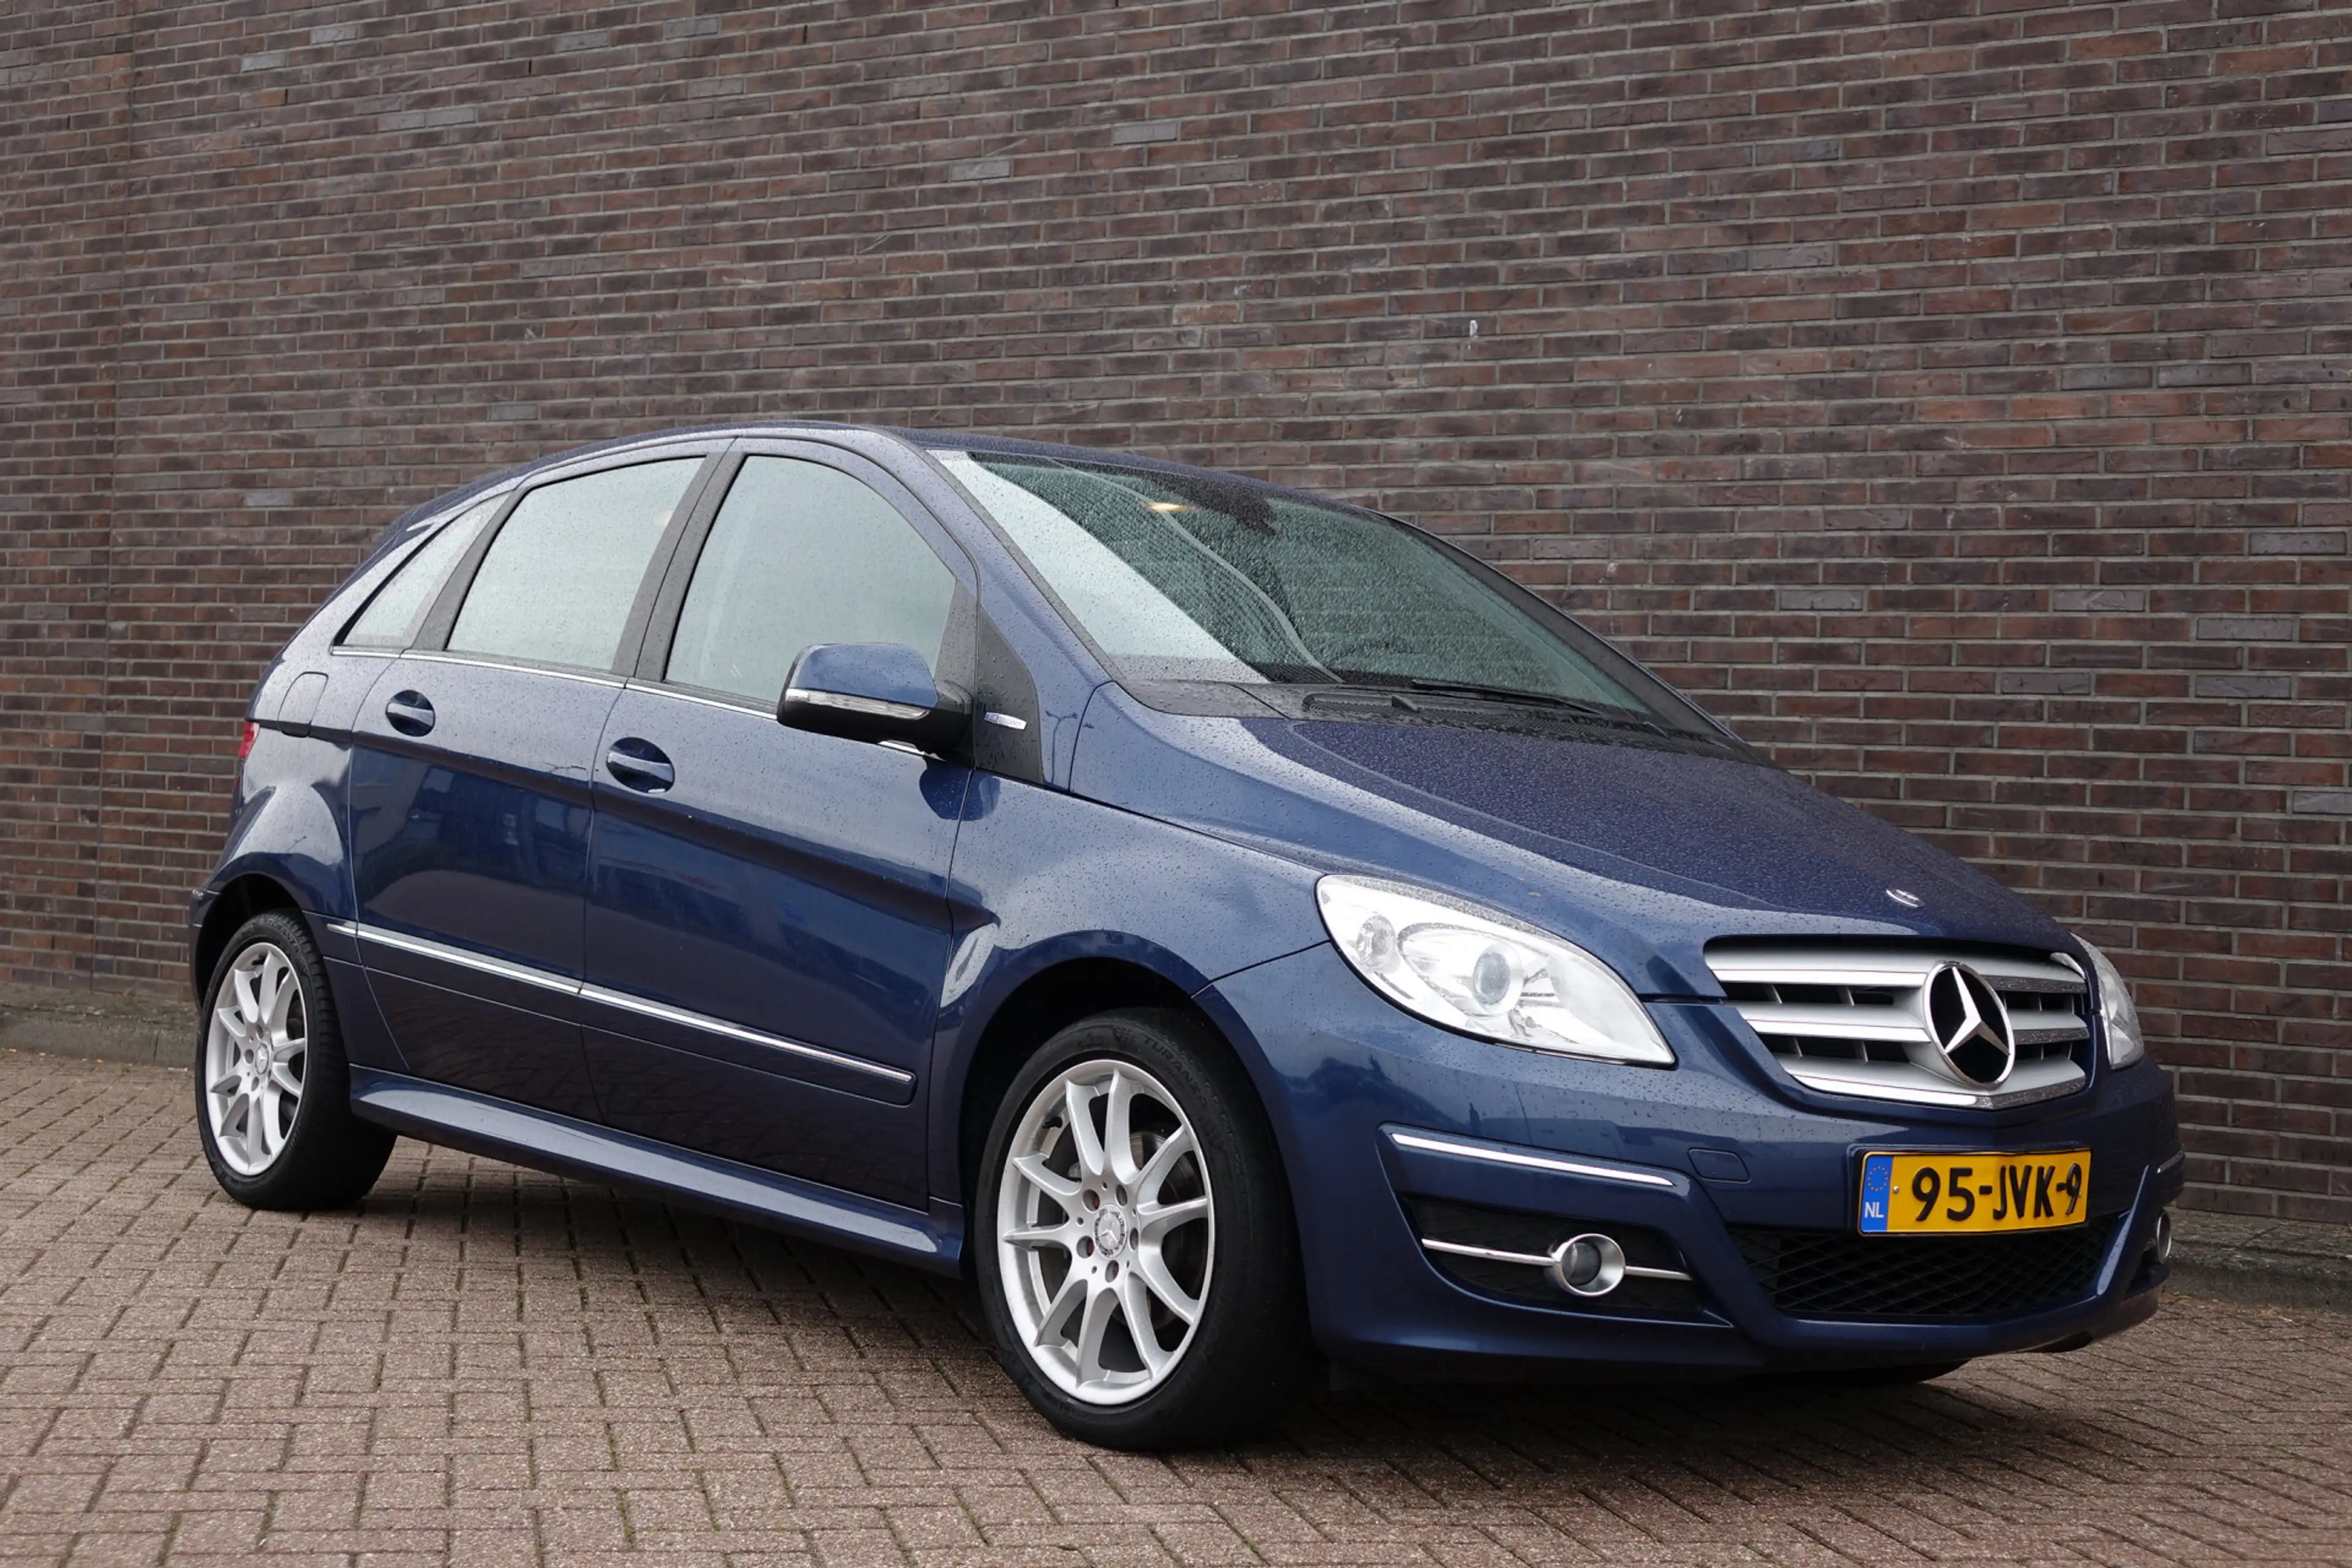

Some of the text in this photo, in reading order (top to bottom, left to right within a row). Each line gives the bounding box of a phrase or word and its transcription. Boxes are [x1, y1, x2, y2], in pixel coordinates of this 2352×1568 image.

[267, 919, 300, 954] TURANZA
[1144, 1035, 1208, 1108] TURANZA
[1864, 1201, 1884, 1218] NL
[1912, 1163, 2082, 1222] 95-JVK-9
